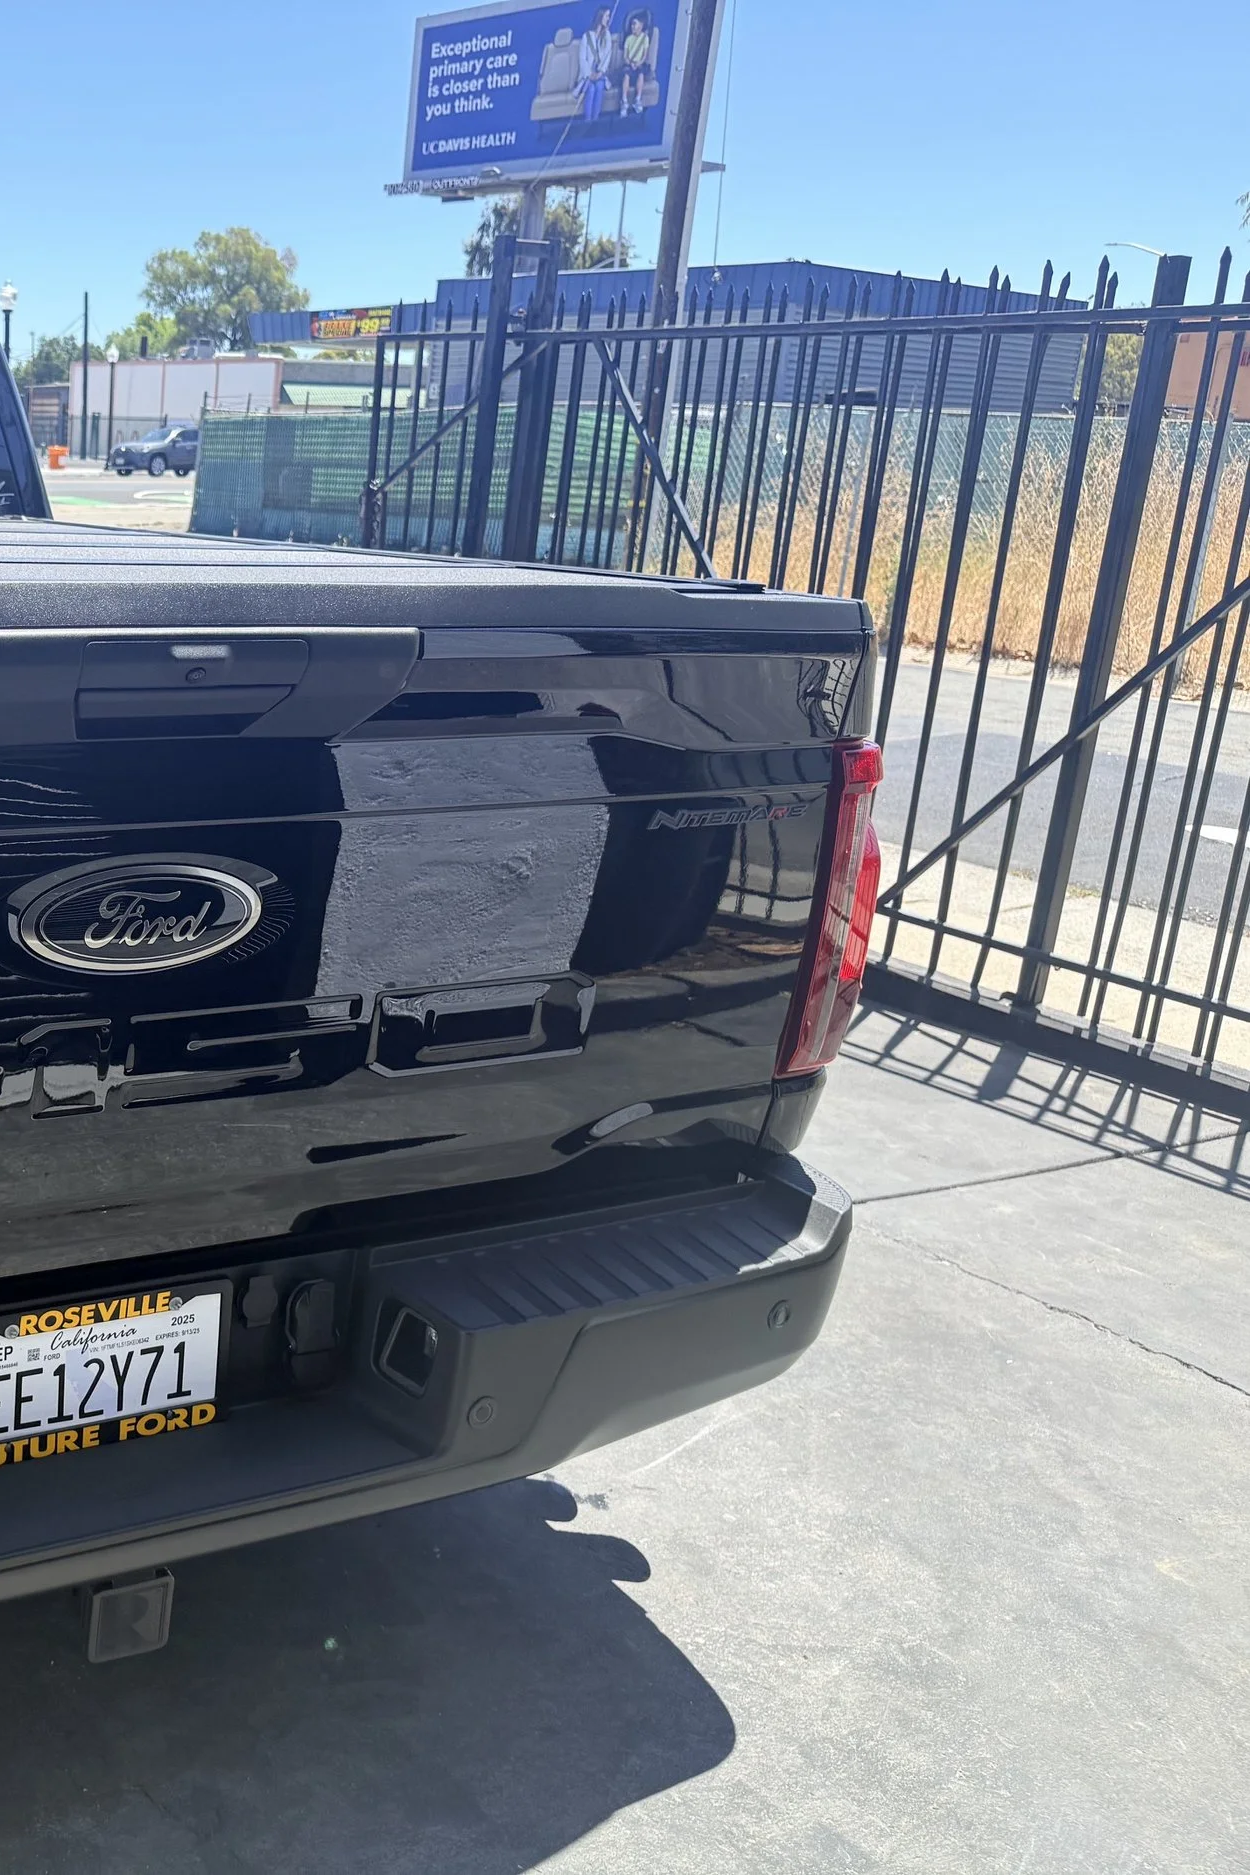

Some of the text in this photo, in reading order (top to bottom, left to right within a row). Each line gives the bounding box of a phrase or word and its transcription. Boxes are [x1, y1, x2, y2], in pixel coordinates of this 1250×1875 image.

[431, 30, 512, 58] Exceptional
[429, 53, 518, 81] primary care
[427, 72, 520, 98] is closer than
[425, 93, 494, 121] you think.
[471, 131, 516, 149] HEALTH
[647, 805, 807, 830] NITEMARE
[84, 890, 212, 949] Ford
[19, 1291, 171, 1337] ROSEVILLE
[171, 1314, 195, 1327] 2025
[50, 1325, 138, 1354] California
[155, 1332, 180, 1341] EXPIRES:
[43, 1353, 61, 1361] FORD
[119, 1403, 216, 1442] FORD
